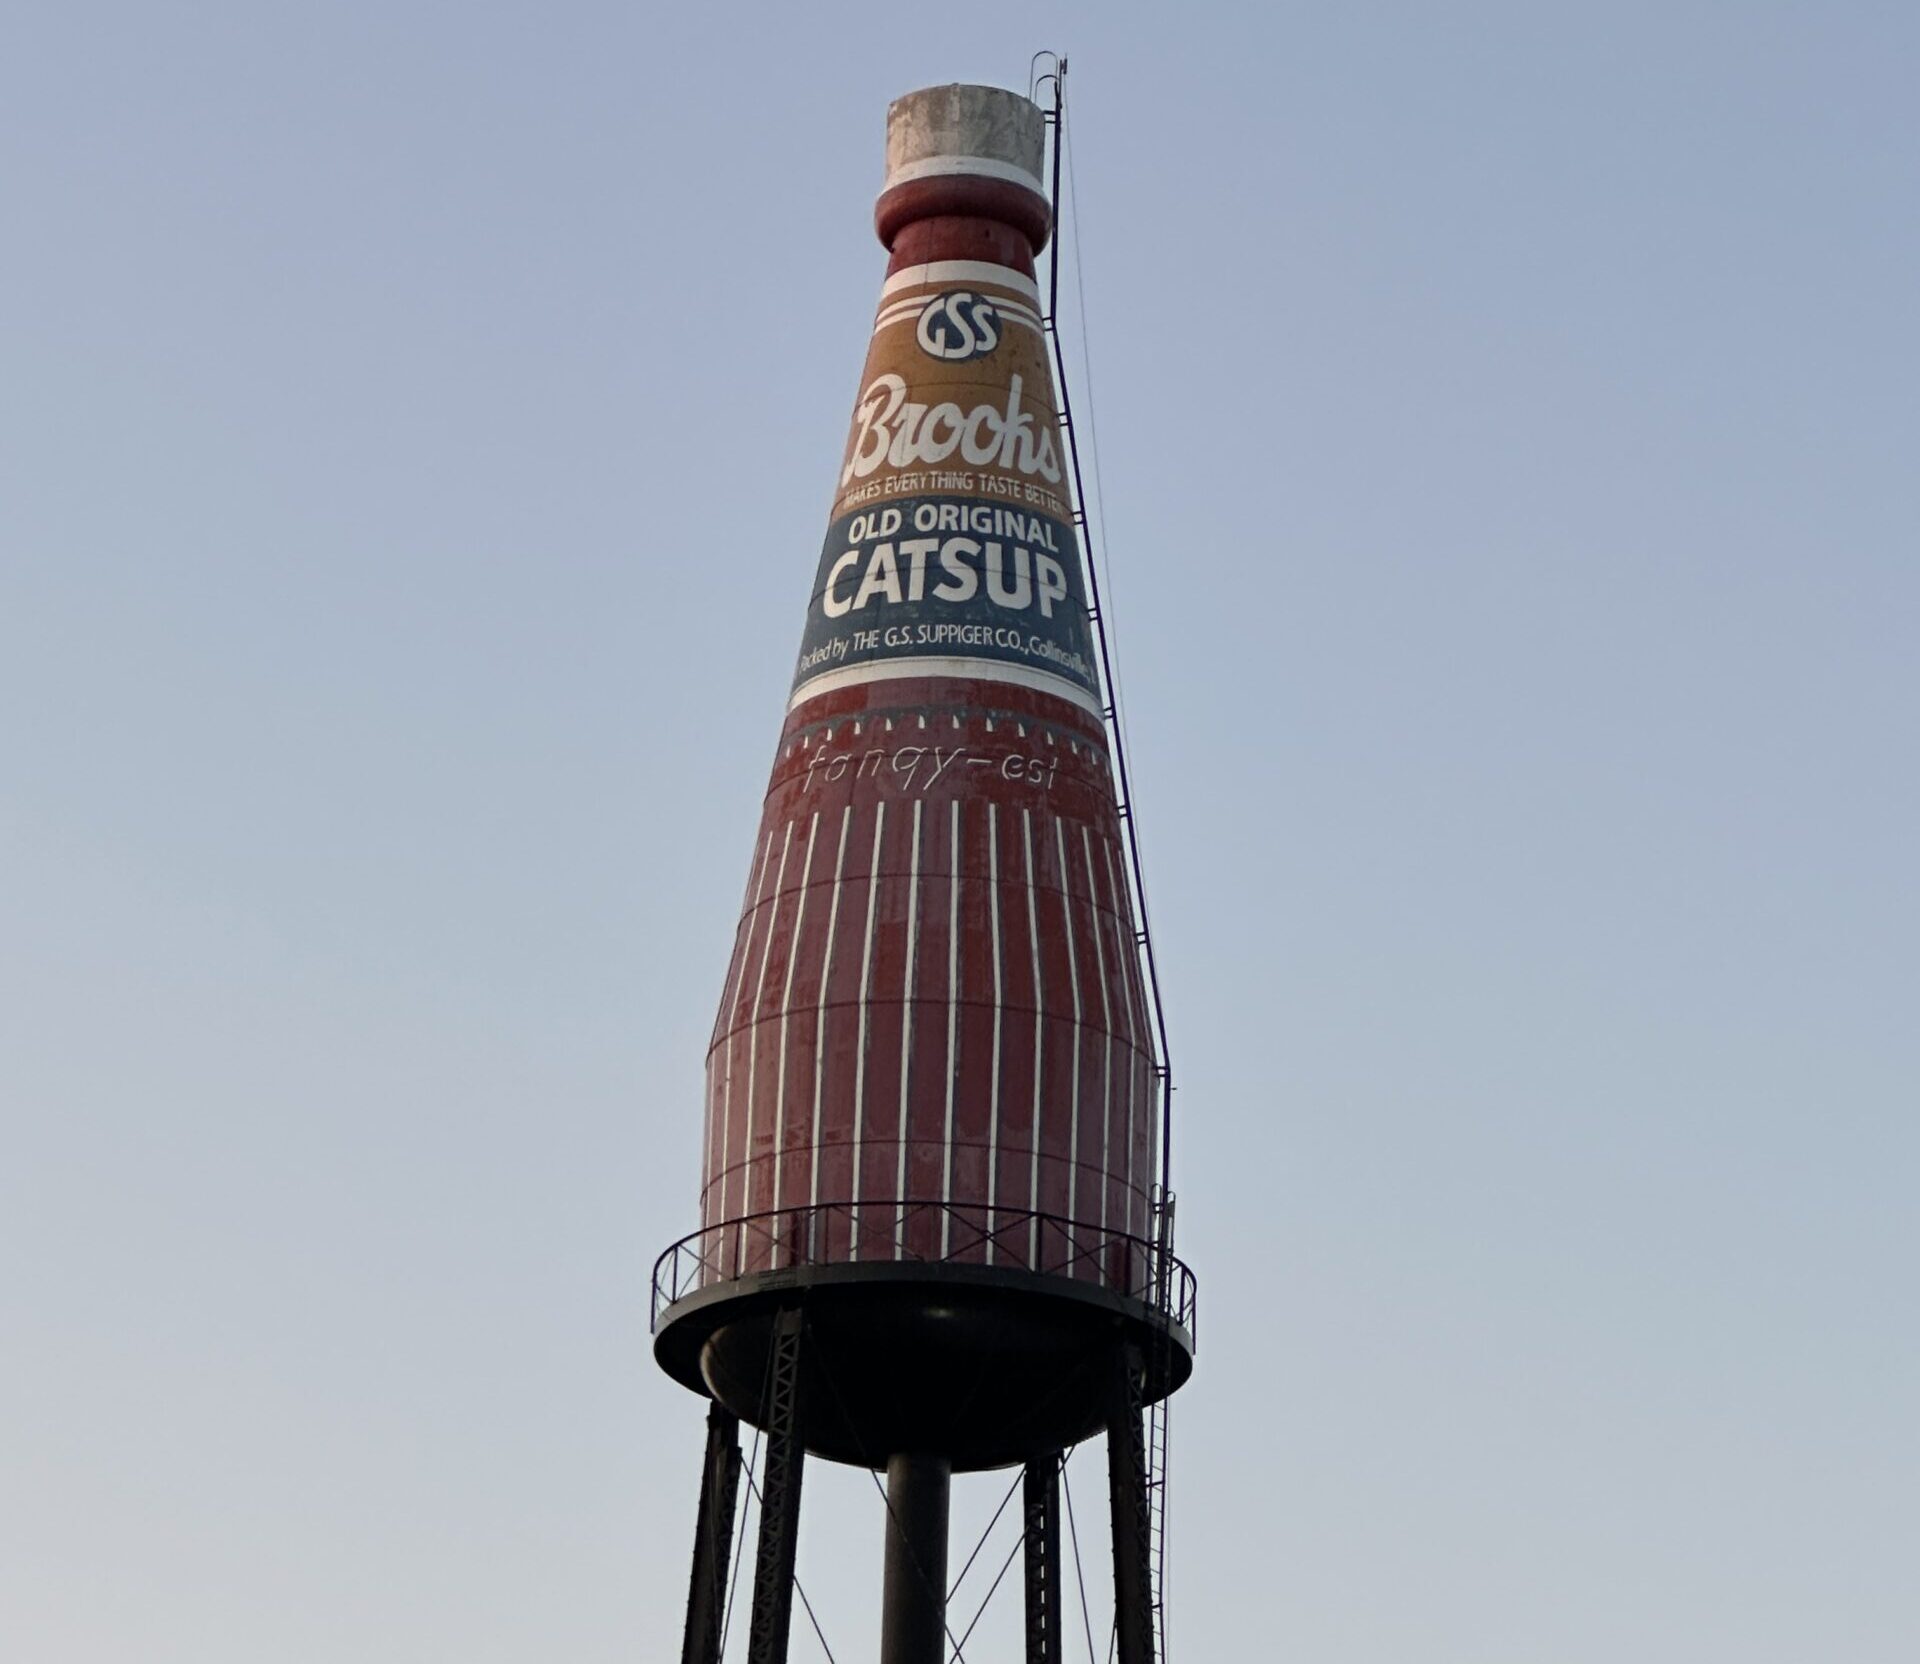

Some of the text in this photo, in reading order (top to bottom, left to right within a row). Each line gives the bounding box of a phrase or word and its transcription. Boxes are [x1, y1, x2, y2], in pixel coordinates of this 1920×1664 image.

[916, 292, 999, 359] GSS
[841, 373, 1061, 484] Brooks
[884, 470, 974, 494] EVERYTHING
[979, 473, 1021, 498] TASTE
[848, 503, 1059, 552] OLD ORIGINAL
[823, 537, 1068, 619] CATSUP
[800, 638, 833, 672] acked
[832, 636, 849, 661] by
[853, 629, 880, 651] THE
[884, 625, 913, 647] G.S.
[917, 623, 993, 646] SUPPIGER
